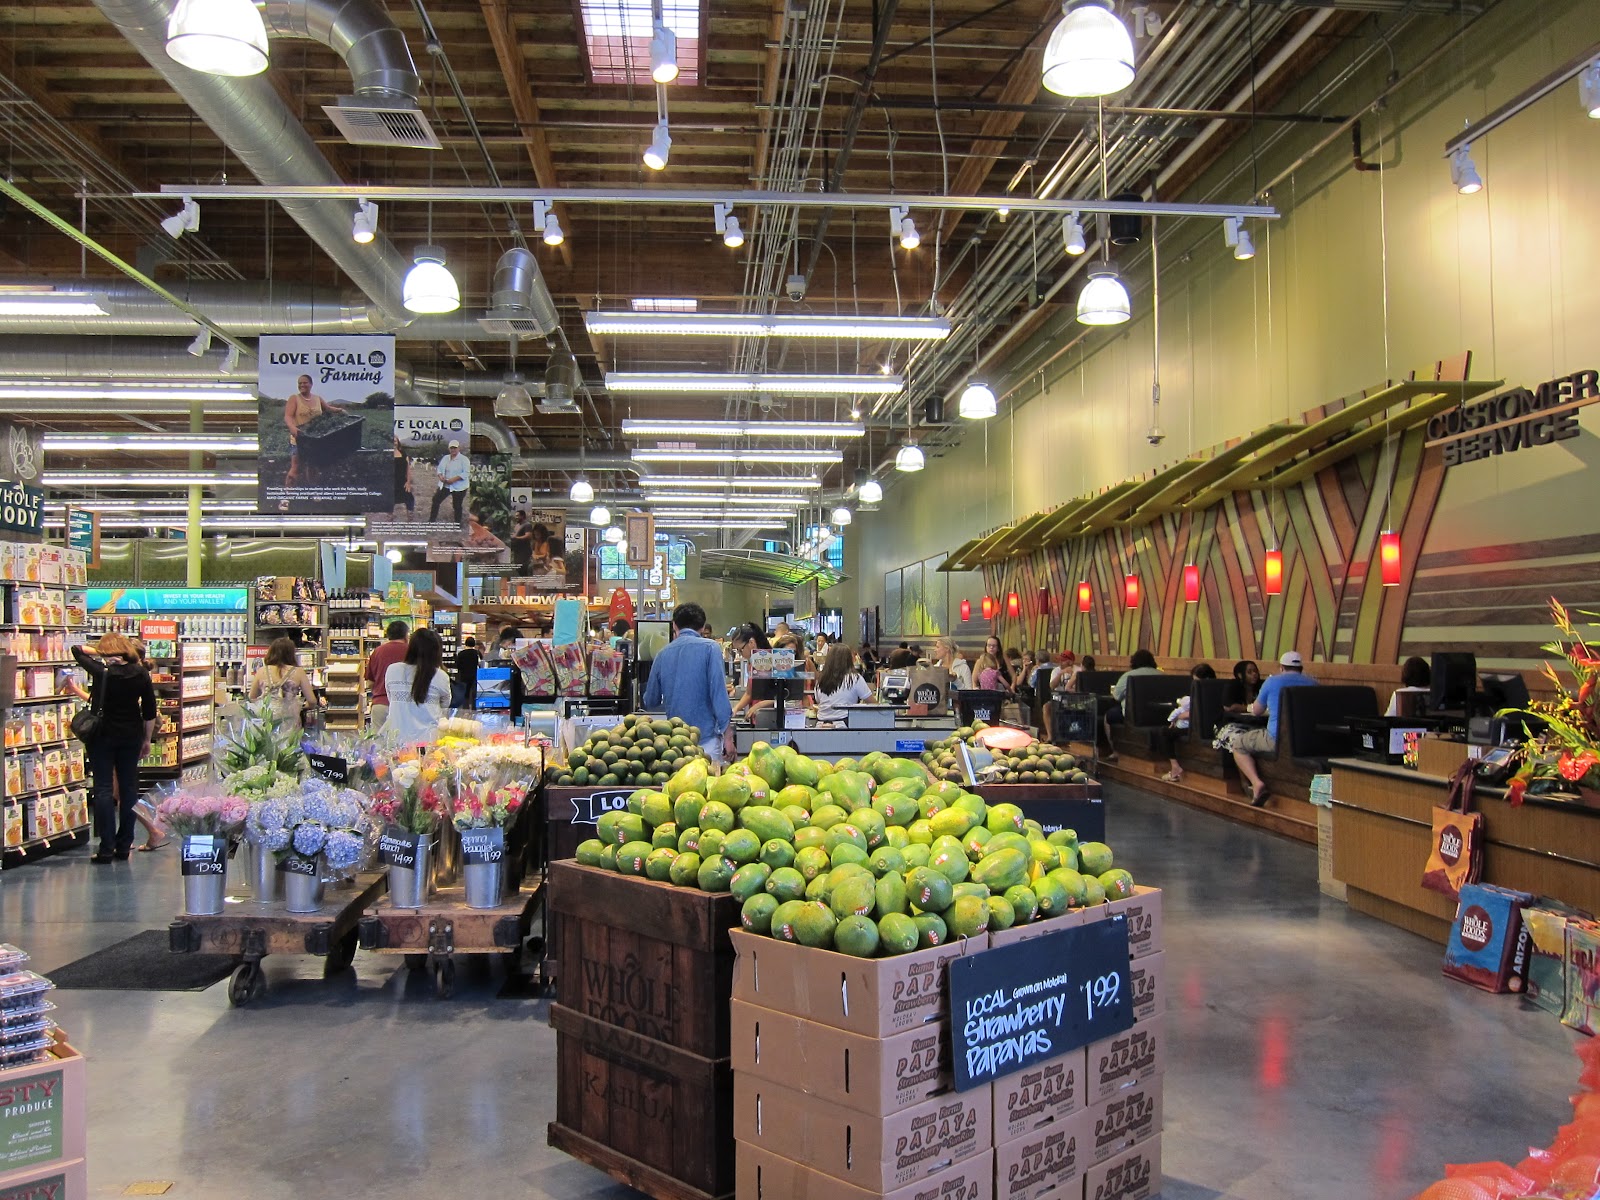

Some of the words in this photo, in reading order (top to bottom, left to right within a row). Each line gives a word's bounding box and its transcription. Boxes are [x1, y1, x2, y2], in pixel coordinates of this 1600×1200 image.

[270, 353, 309, 365] LOVE
[316, 353, 366, 365] LOCAL
[320, 367, 383, 385] Farming
[1427, 369, 1599, 440] CUSTOMER
[394, 420, 404, 429] VE
[409, 420, 448, 430] LOCAL
[411, 430, 444, 442] Dairy
[1443, 408, 1580, 466] SERVICE
[470, 464, 493, 472] OCAL
[0, 487, 39, 509] HOLE
[0, 505, 37, 528] ODY
[651, 575, 661, 584] 3
[661, 591, 670, 599] 5
[144, 626, 159, 635] GREAT
[159, 625, 175, 635] VALUE!
[311, 759, 325, 768] Iris
[601, 796, 629, 811] LO
[1441, 842, 1459, 854] FOODS
[1442, 833, 1462, 848] WHOLE
[1128, 913, 1152, 933] AYA
[1462, 924, 1486, 939] FOODS
[1464, 915, 1488, 931] WHOLE
[1513, 922, 1529, 974] ARIZON
[908, 961, 934, 977] Kumu
[582, 957, 680, 1023] WHOLE
[893, 970, 945, 1000] PAPA
[894, 992, 940, 1014] Strawberry
[966, 989, 1012, 1021] LOCAL
[1012, 987, 1033, 999] Grown
[1033, 982, 1043, 993] on
[964, 993, 1066, 1047] Strawberry
[896, 1048, 937, 1077] PAP
[966, 1028, 1052, 1079] Papayas
[1099, 1036, 1156, 1073] PAPAYA
[897, 1067, 940, 1091] Strawberry
[1008, 1069, 1074, 1110] PAPAYA
[0, 1078, 59, 1107] STY
[584, 1071, 673, 1123] KAILUA
[5, 1099, 53, 1118] PRODUCE
[911, 1112, 937, 1131] Kumu
[938, 1101, 963, 1120] Farms
[1095, 1097, 1153, 1137] PAPAYA
[895, 1108, 977, 1156] PAPAYA
[897, 1142, 942, 1170] Strawberry
[1009, 1136, 1076, 1182] PAPAYA
[941, 1175, 965, 1195] Farms
[1095, 1159, 1150, 1200] PAPAYA
